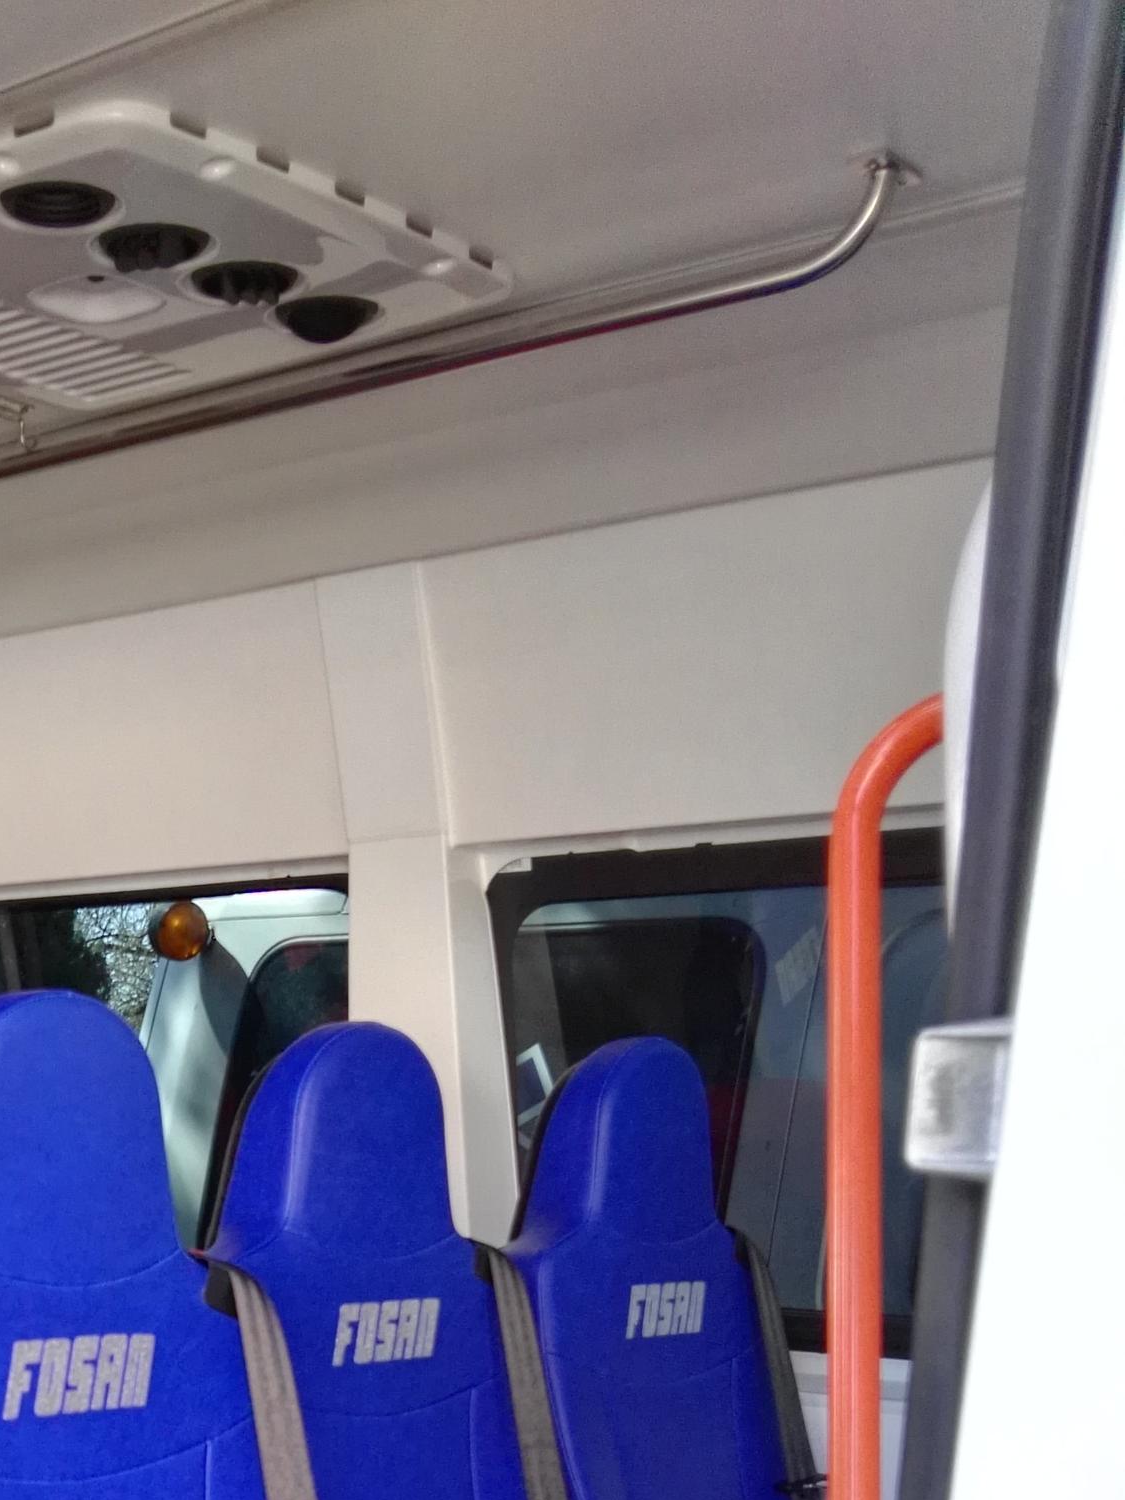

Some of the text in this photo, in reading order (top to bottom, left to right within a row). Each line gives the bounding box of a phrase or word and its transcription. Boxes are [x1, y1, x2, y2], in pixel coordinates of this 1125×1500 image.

[332, 1297, 440, 1367] FOSAN
[625, 1280, 706, 1340] FOSAN
[2, 1333, 156, 1421] FOSAN
